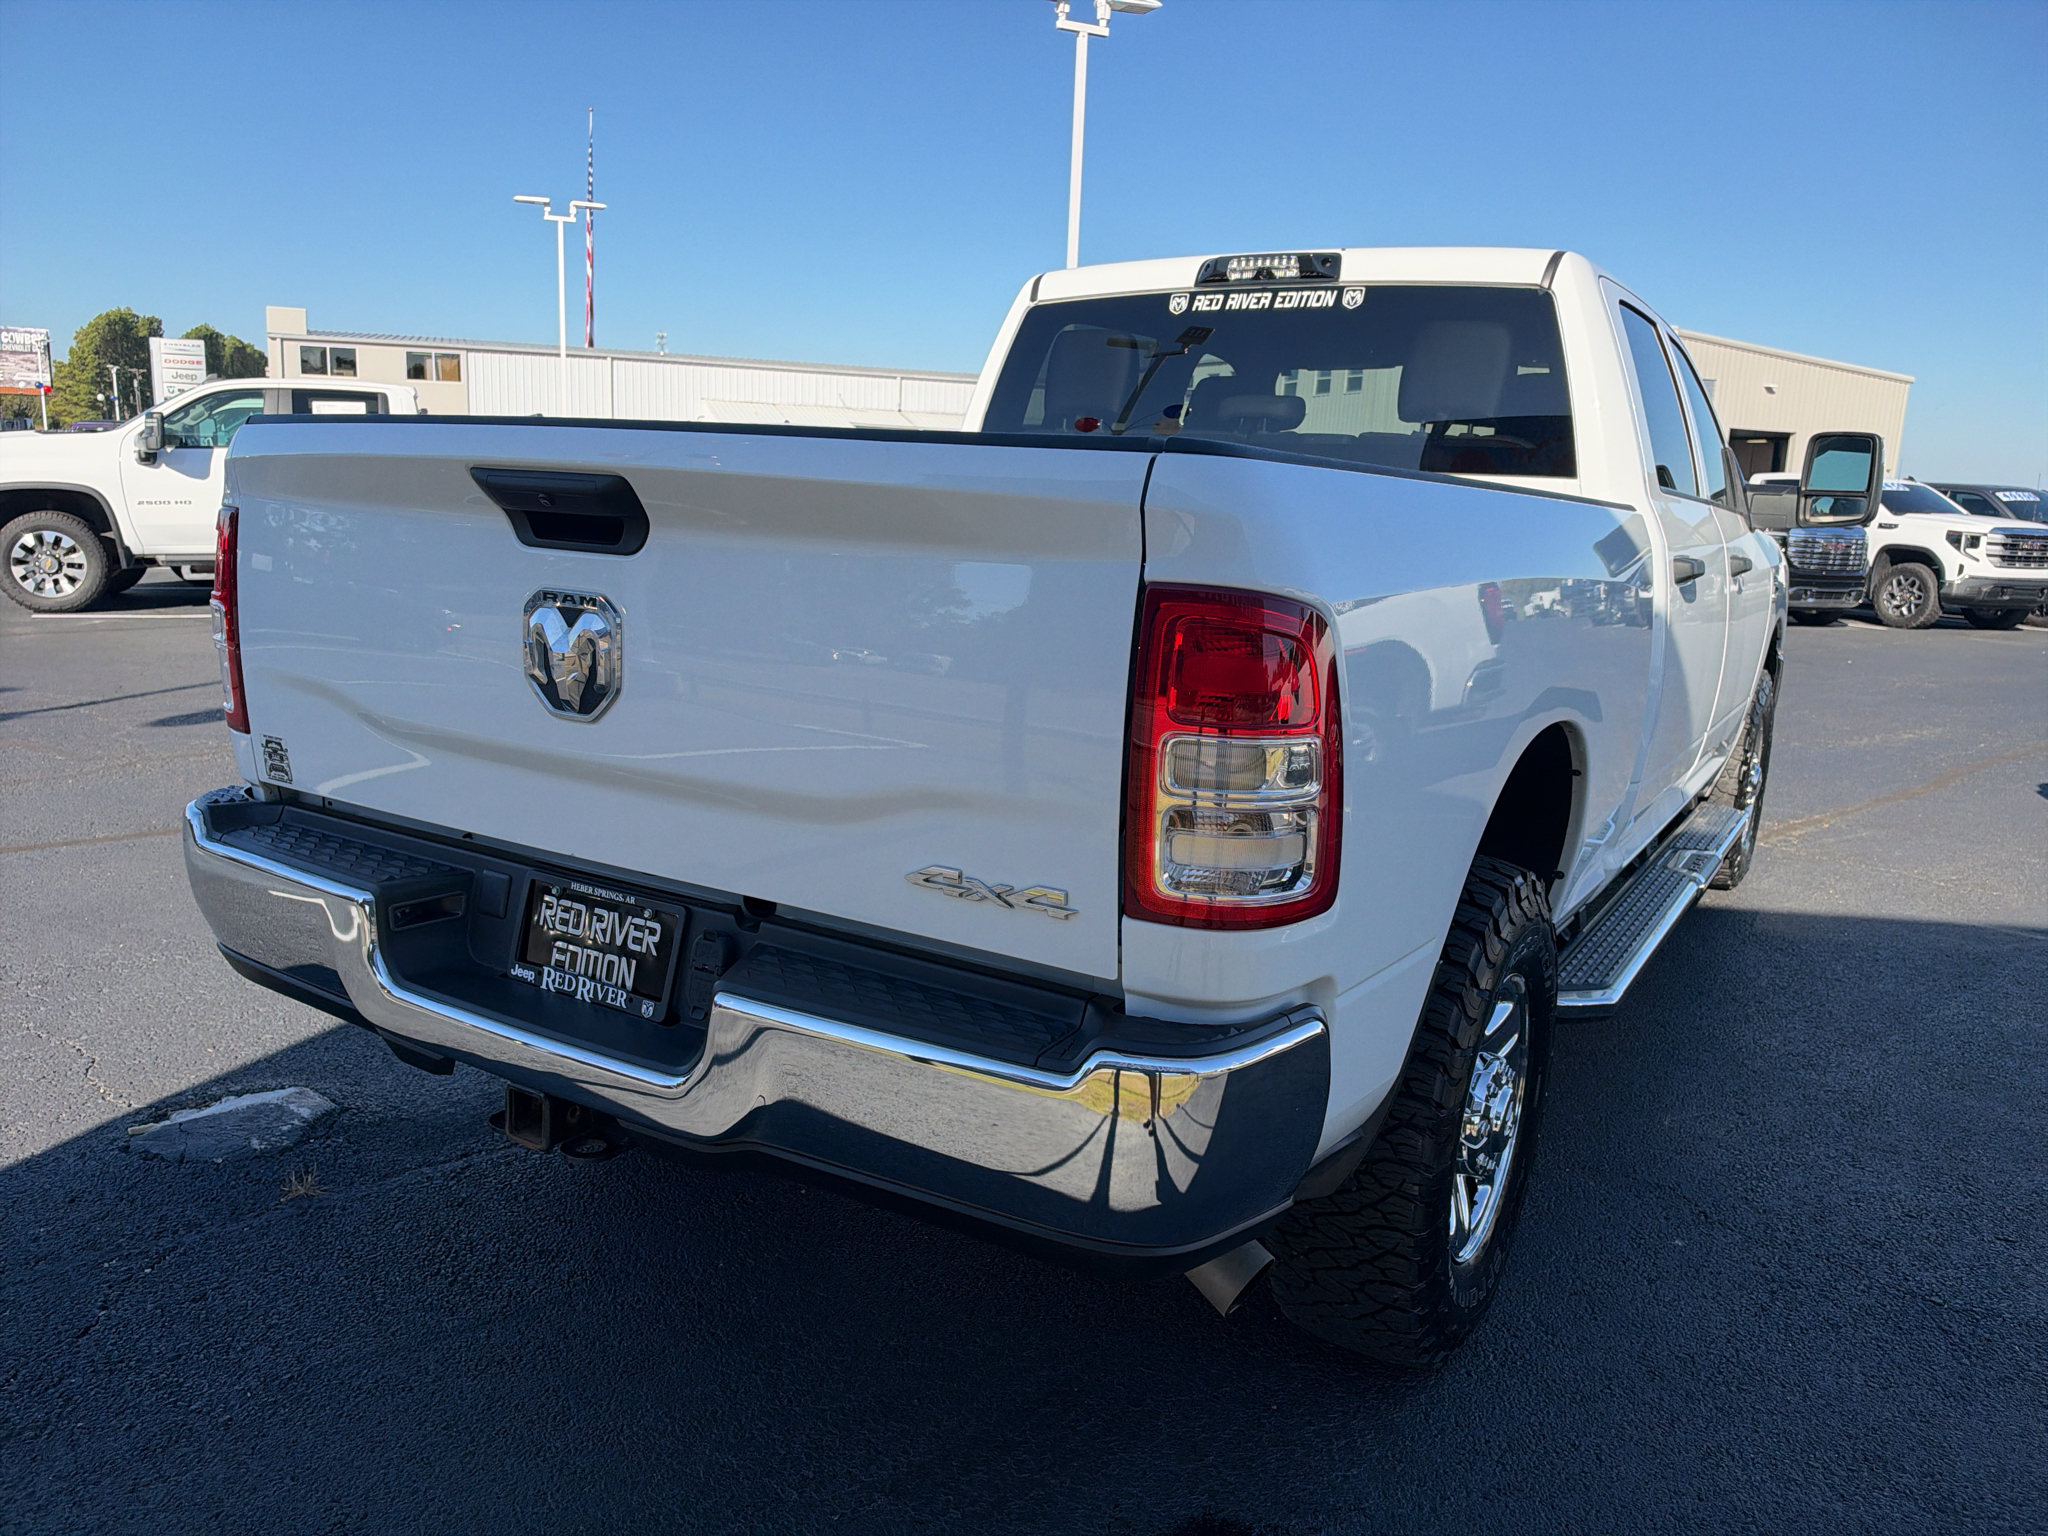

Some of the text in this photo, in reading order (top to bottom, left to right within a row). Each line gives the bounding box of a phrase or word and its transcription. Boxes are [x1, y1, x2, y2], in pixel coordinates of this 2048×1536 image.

[1192, 290, 1338, 311] RED RIVER EDITION
[171, 371, 198, 381] Jeep
[542, 592, 598, 607] RAM
[570, 881, 636, 905] HEBER SPRINGS, AR
[539, 894, 662, 957] RED RIVER
[510, 963, 535, 983] Jeep
[551, 940, 637, 992] EDITION
